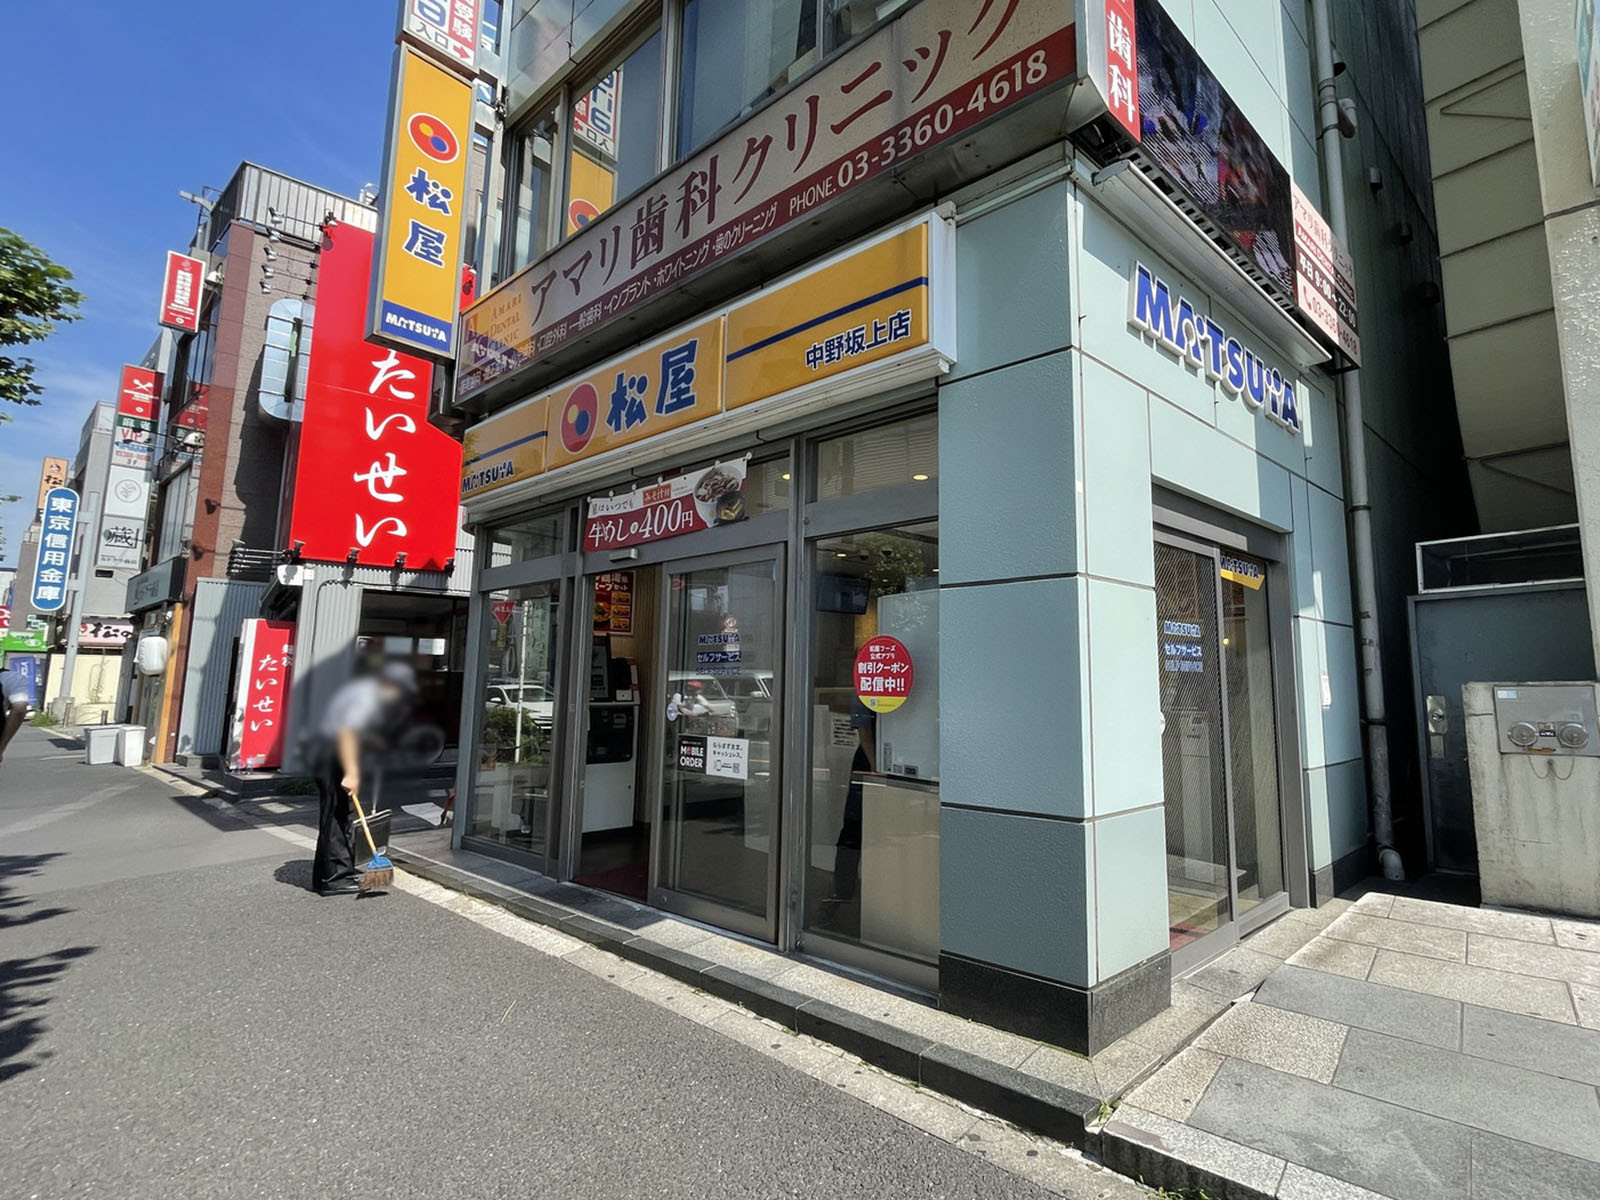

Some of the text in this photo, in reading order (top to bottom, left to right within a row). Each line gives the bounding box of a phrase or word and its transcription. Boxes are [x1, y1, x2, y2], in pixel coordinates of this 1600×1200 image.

[416, 21, 448, 49] 入口
[1107, 12, 1135, 123] 歯科
[789, 176, 836, 217] PHONE.
[837, 49, 1048, 188] 03-3360-4618
[531, 0, 1020, 328] アマリ歯科クリニック
[404, 167, 452, 267] 松屋
[1299, 252, 1314, 281] 平日
[384, 311, 447, 342] MATSUYA
[805, 308, 911, 371] 中野坂上店
[1128, 261, 1300, 434] MATSUYA
[605, 338, 700, 435] 松屋
[353, 348, 416, 547] たいせい
[461, 459, 514, 494] MATSUYA
[36, 497, 74, 601] 東京信用金庫
[697, 651, 741, 663] セルフサービス
[698, 633, 741, 645] MATSUYA
[250, 654, 278, 732] たいせい
[857, 662, 909, 675] 割引クーポン
[860, 677, 905, 692] 配信中!!
[680, 745, 704, 757] MOBILE
[680, 756, 704, 768] ORDER
